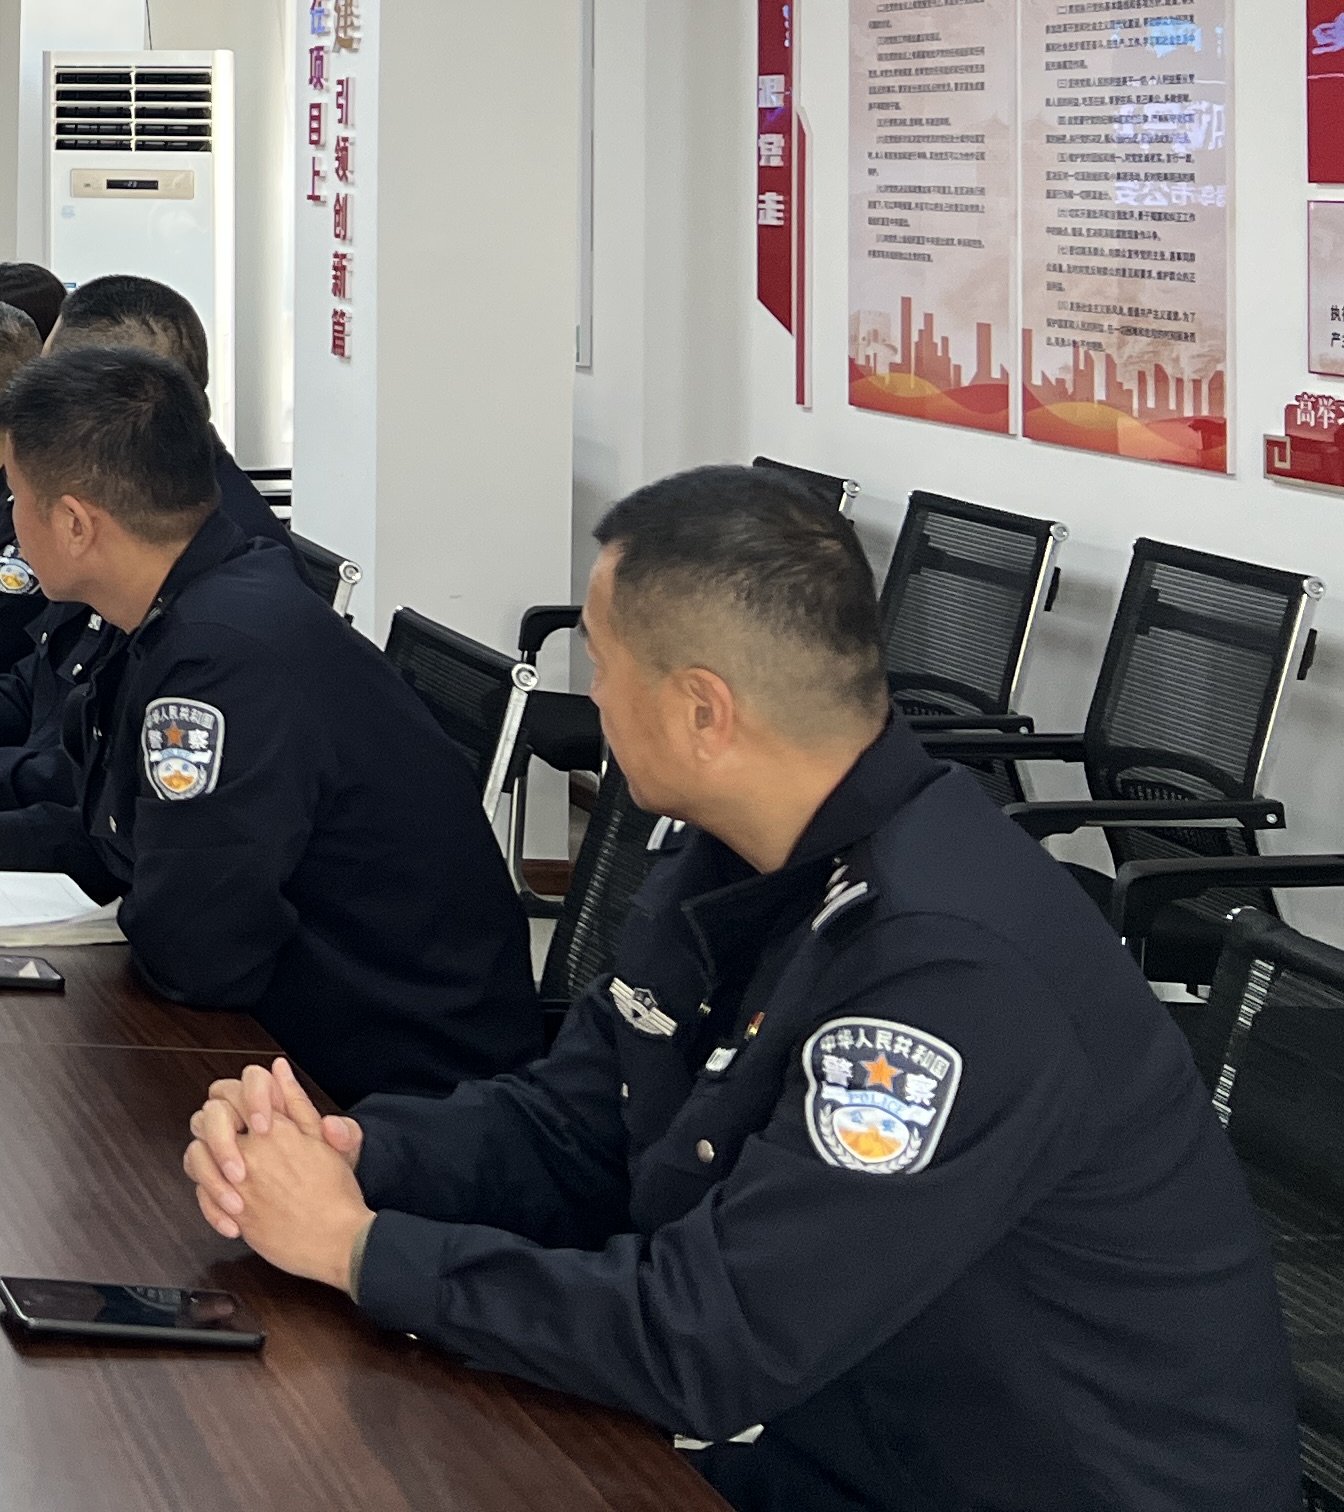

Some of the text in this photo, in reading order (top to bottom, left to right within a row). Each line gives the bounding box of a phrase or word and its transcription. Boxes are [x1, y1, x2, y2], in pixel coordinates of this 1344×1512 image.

[820, 1028, 951, 1081] 中华人民共和国
